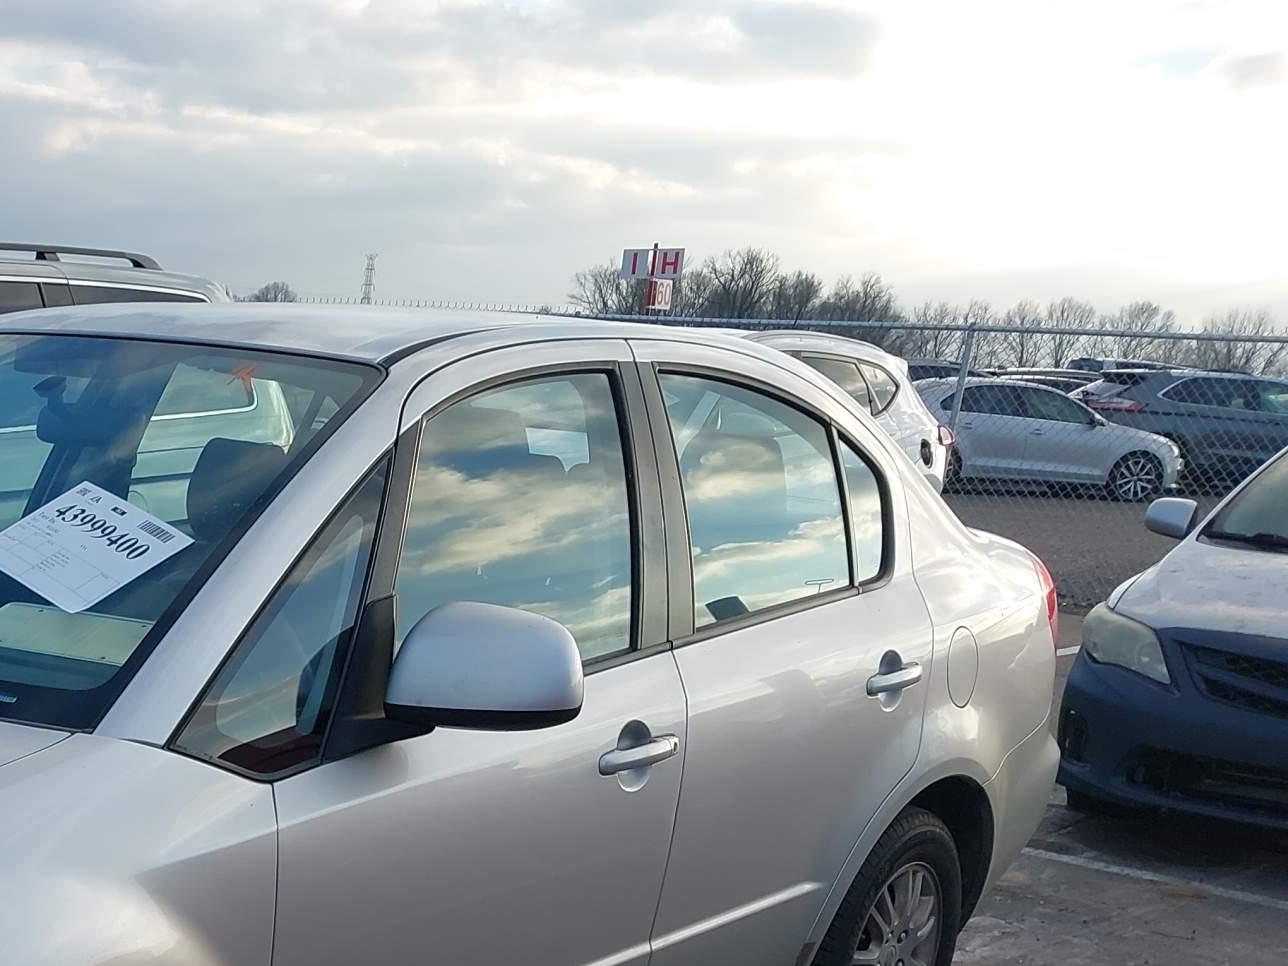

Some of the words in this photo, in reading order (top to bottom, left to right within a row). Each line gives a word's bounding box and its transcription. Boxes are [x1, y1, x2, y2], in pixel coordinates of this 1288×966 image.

[661, 251, 680, 275] H
[656, 282, 672, 306] 60
[55, 504, 150, 560] 43999400
